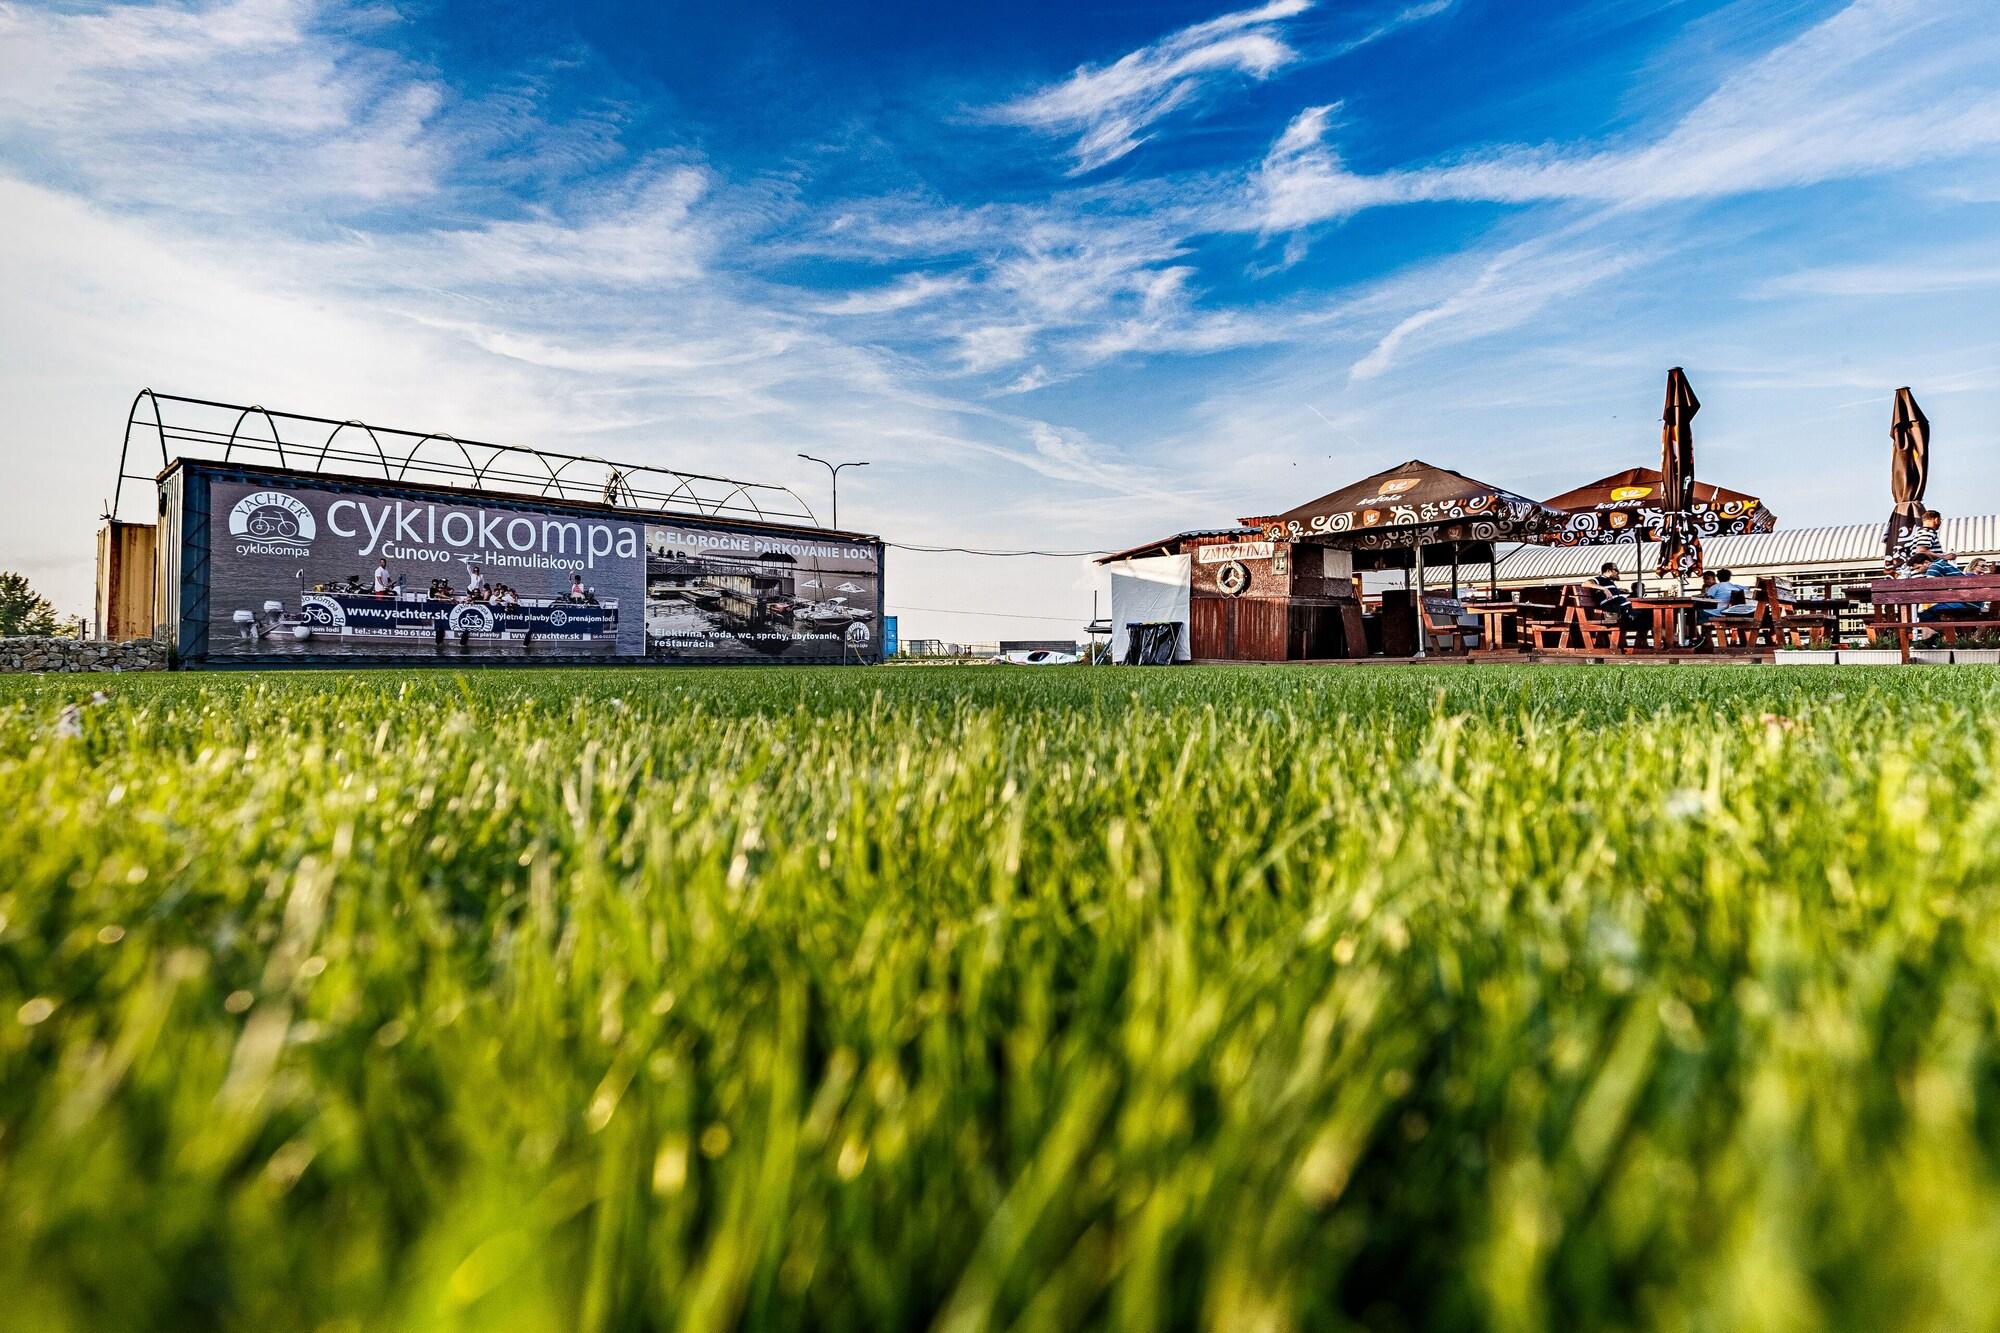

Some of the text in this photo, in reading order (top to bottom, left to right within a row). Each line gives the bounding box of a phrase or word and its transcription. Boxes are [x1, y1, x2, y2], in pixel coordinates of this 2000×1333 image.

[1594, 500, 1642, 510] kofola
[327, 500, 637, 568] cyklokompa
[236, 543, 310, 558] cyklokompa
[655, 530, 750, 551] CELOROČNÉ
[754, 541, 839, 558] PARKOVANIE
[381, 540, 585, 571] Čunovo Hamuliakovo
[1202, 543, 1270, 561] ZMRZLINA
[347, 607, 449, 620] www.yachter.sk
[709, 630, 735, 639] voda,
[756, 632, 789, 640] sprchy,
[654, 639, 715, 648] reštaurácia
